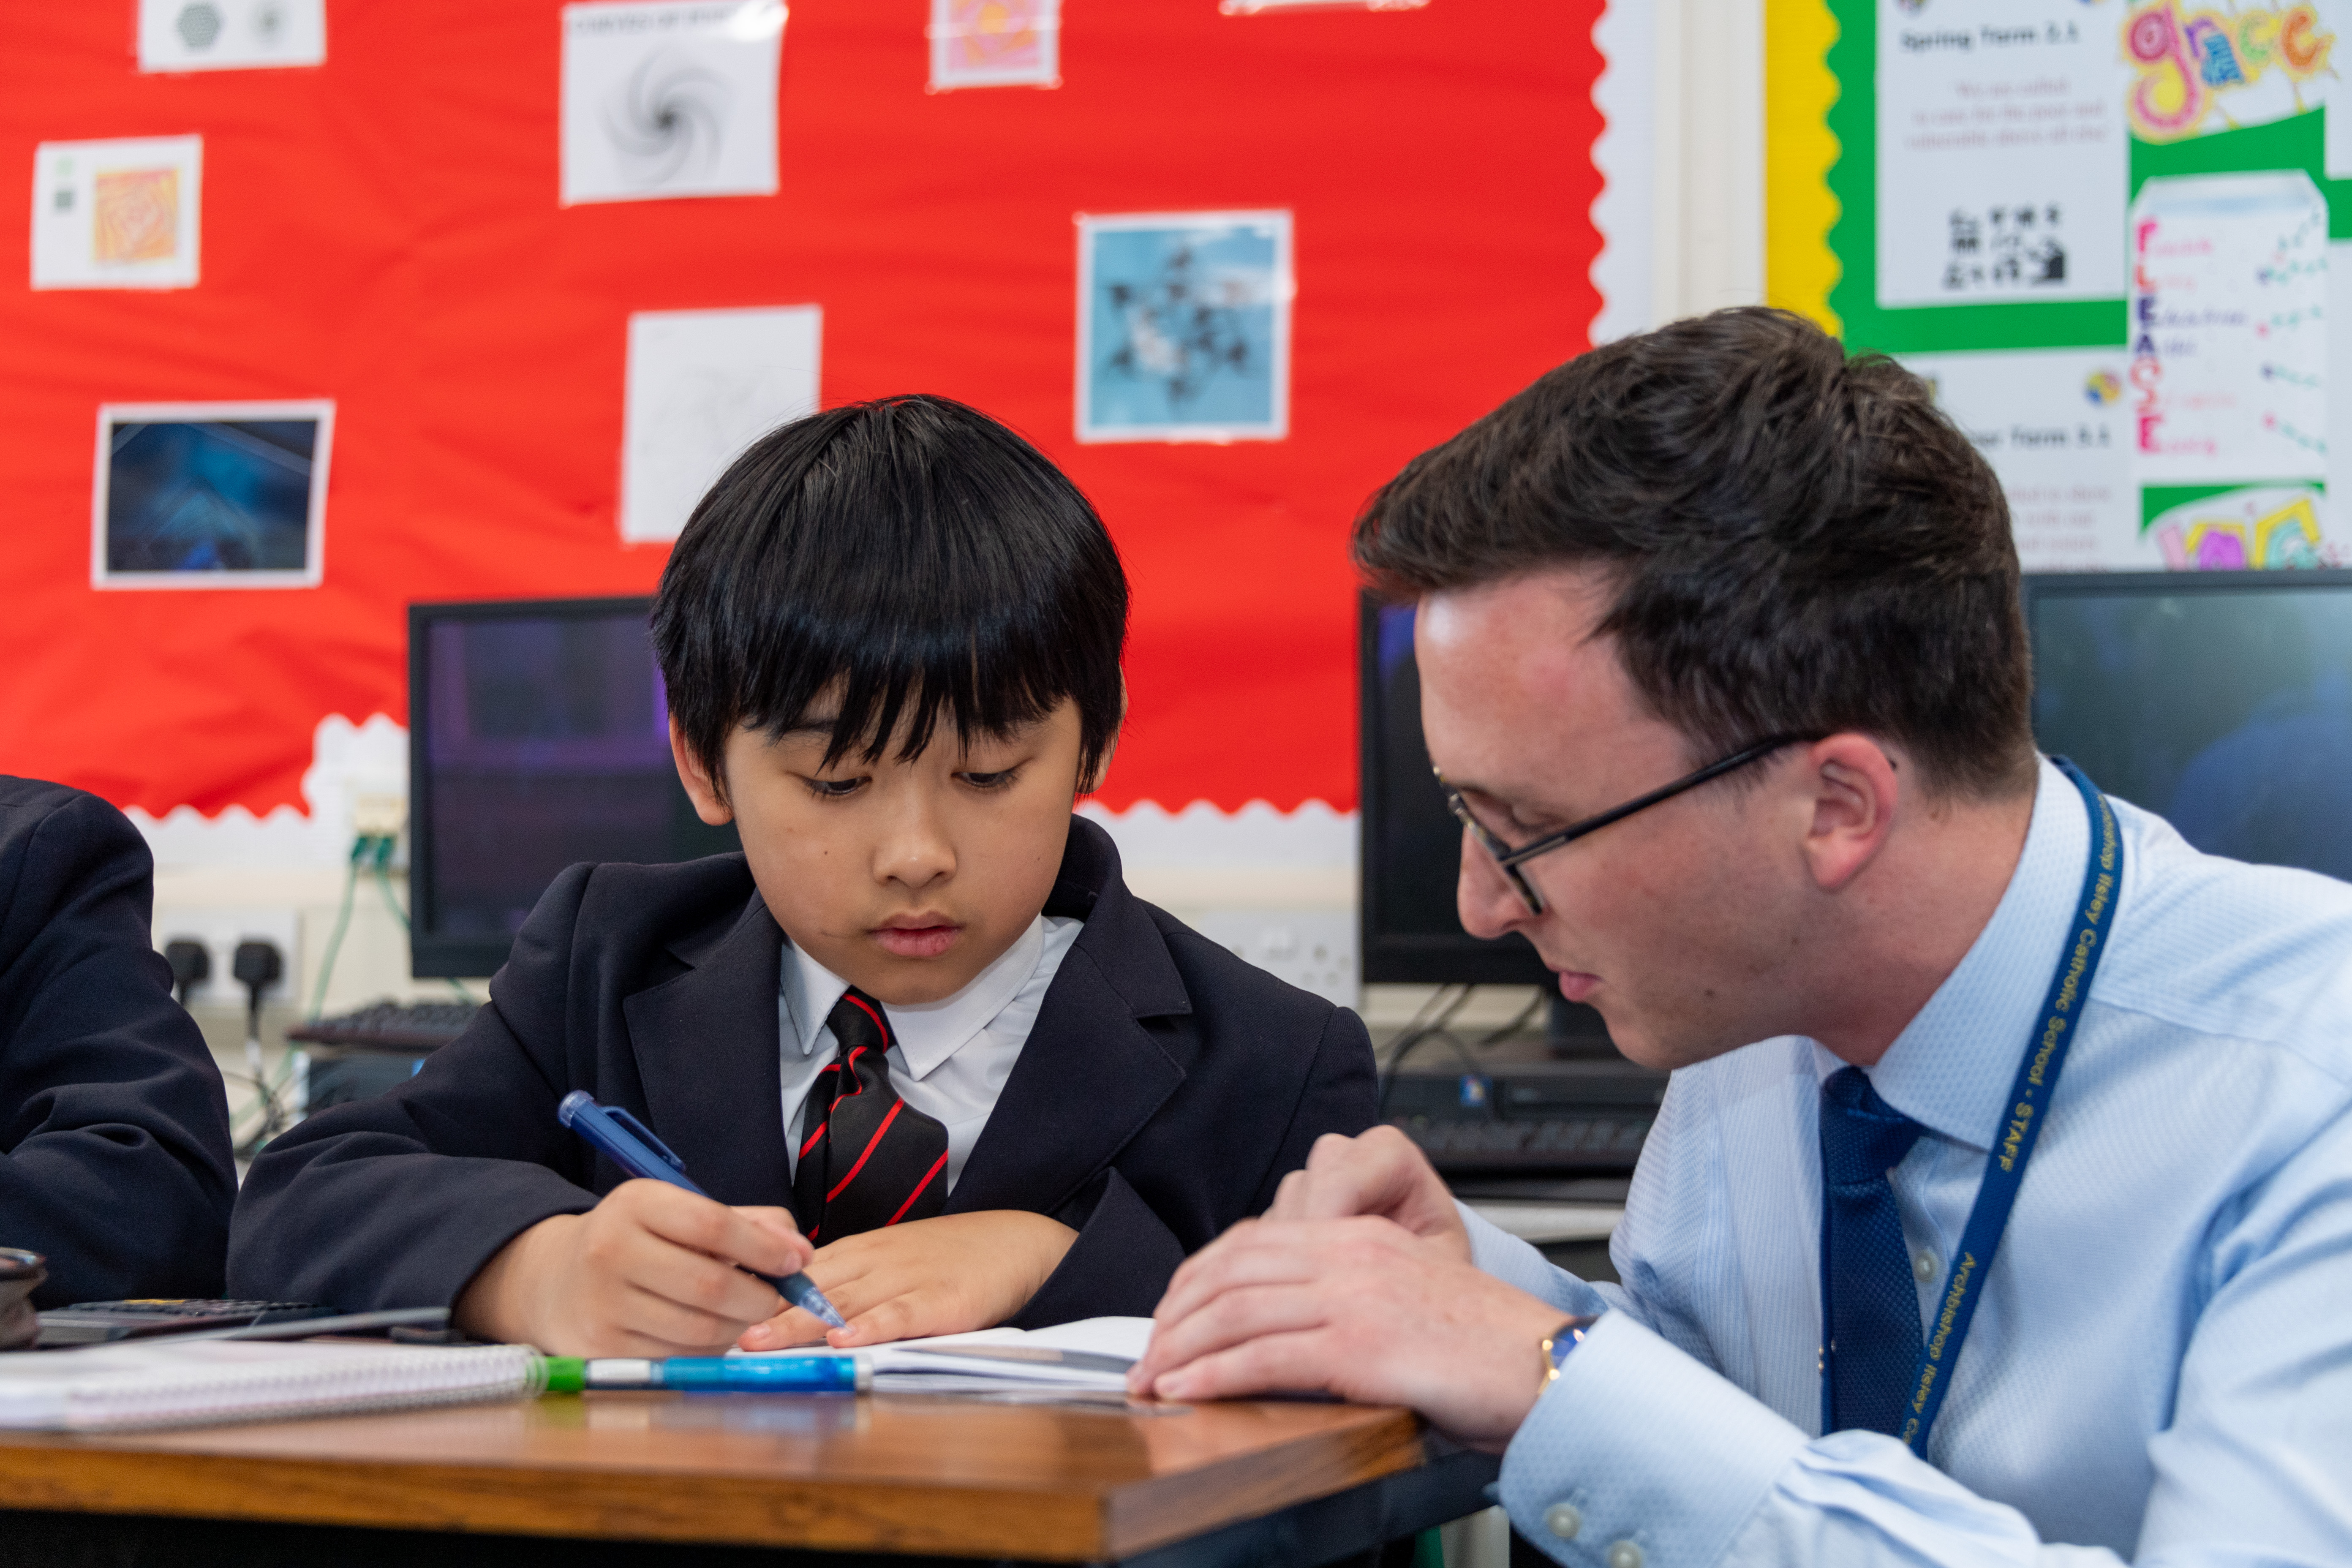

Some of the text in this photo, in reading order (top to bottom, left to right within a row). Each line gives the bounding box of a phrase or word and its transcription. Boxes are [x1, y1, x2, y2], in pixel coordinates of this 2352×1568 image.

[1902, 30, 1970, 52] Spring
[1980, 26, 2035, 46] Term
[2123, 3, 2335, 143] grace
[2055, 928, 2097, 1013] Catholic
[2028, 1015, 2067, 1086] School
[1998, 1102, 2034, 1173] STAFF
[1929, 1251, 1976, 1361] Archbishop
[1911, 1364, 1938, 1414] Ilsley
